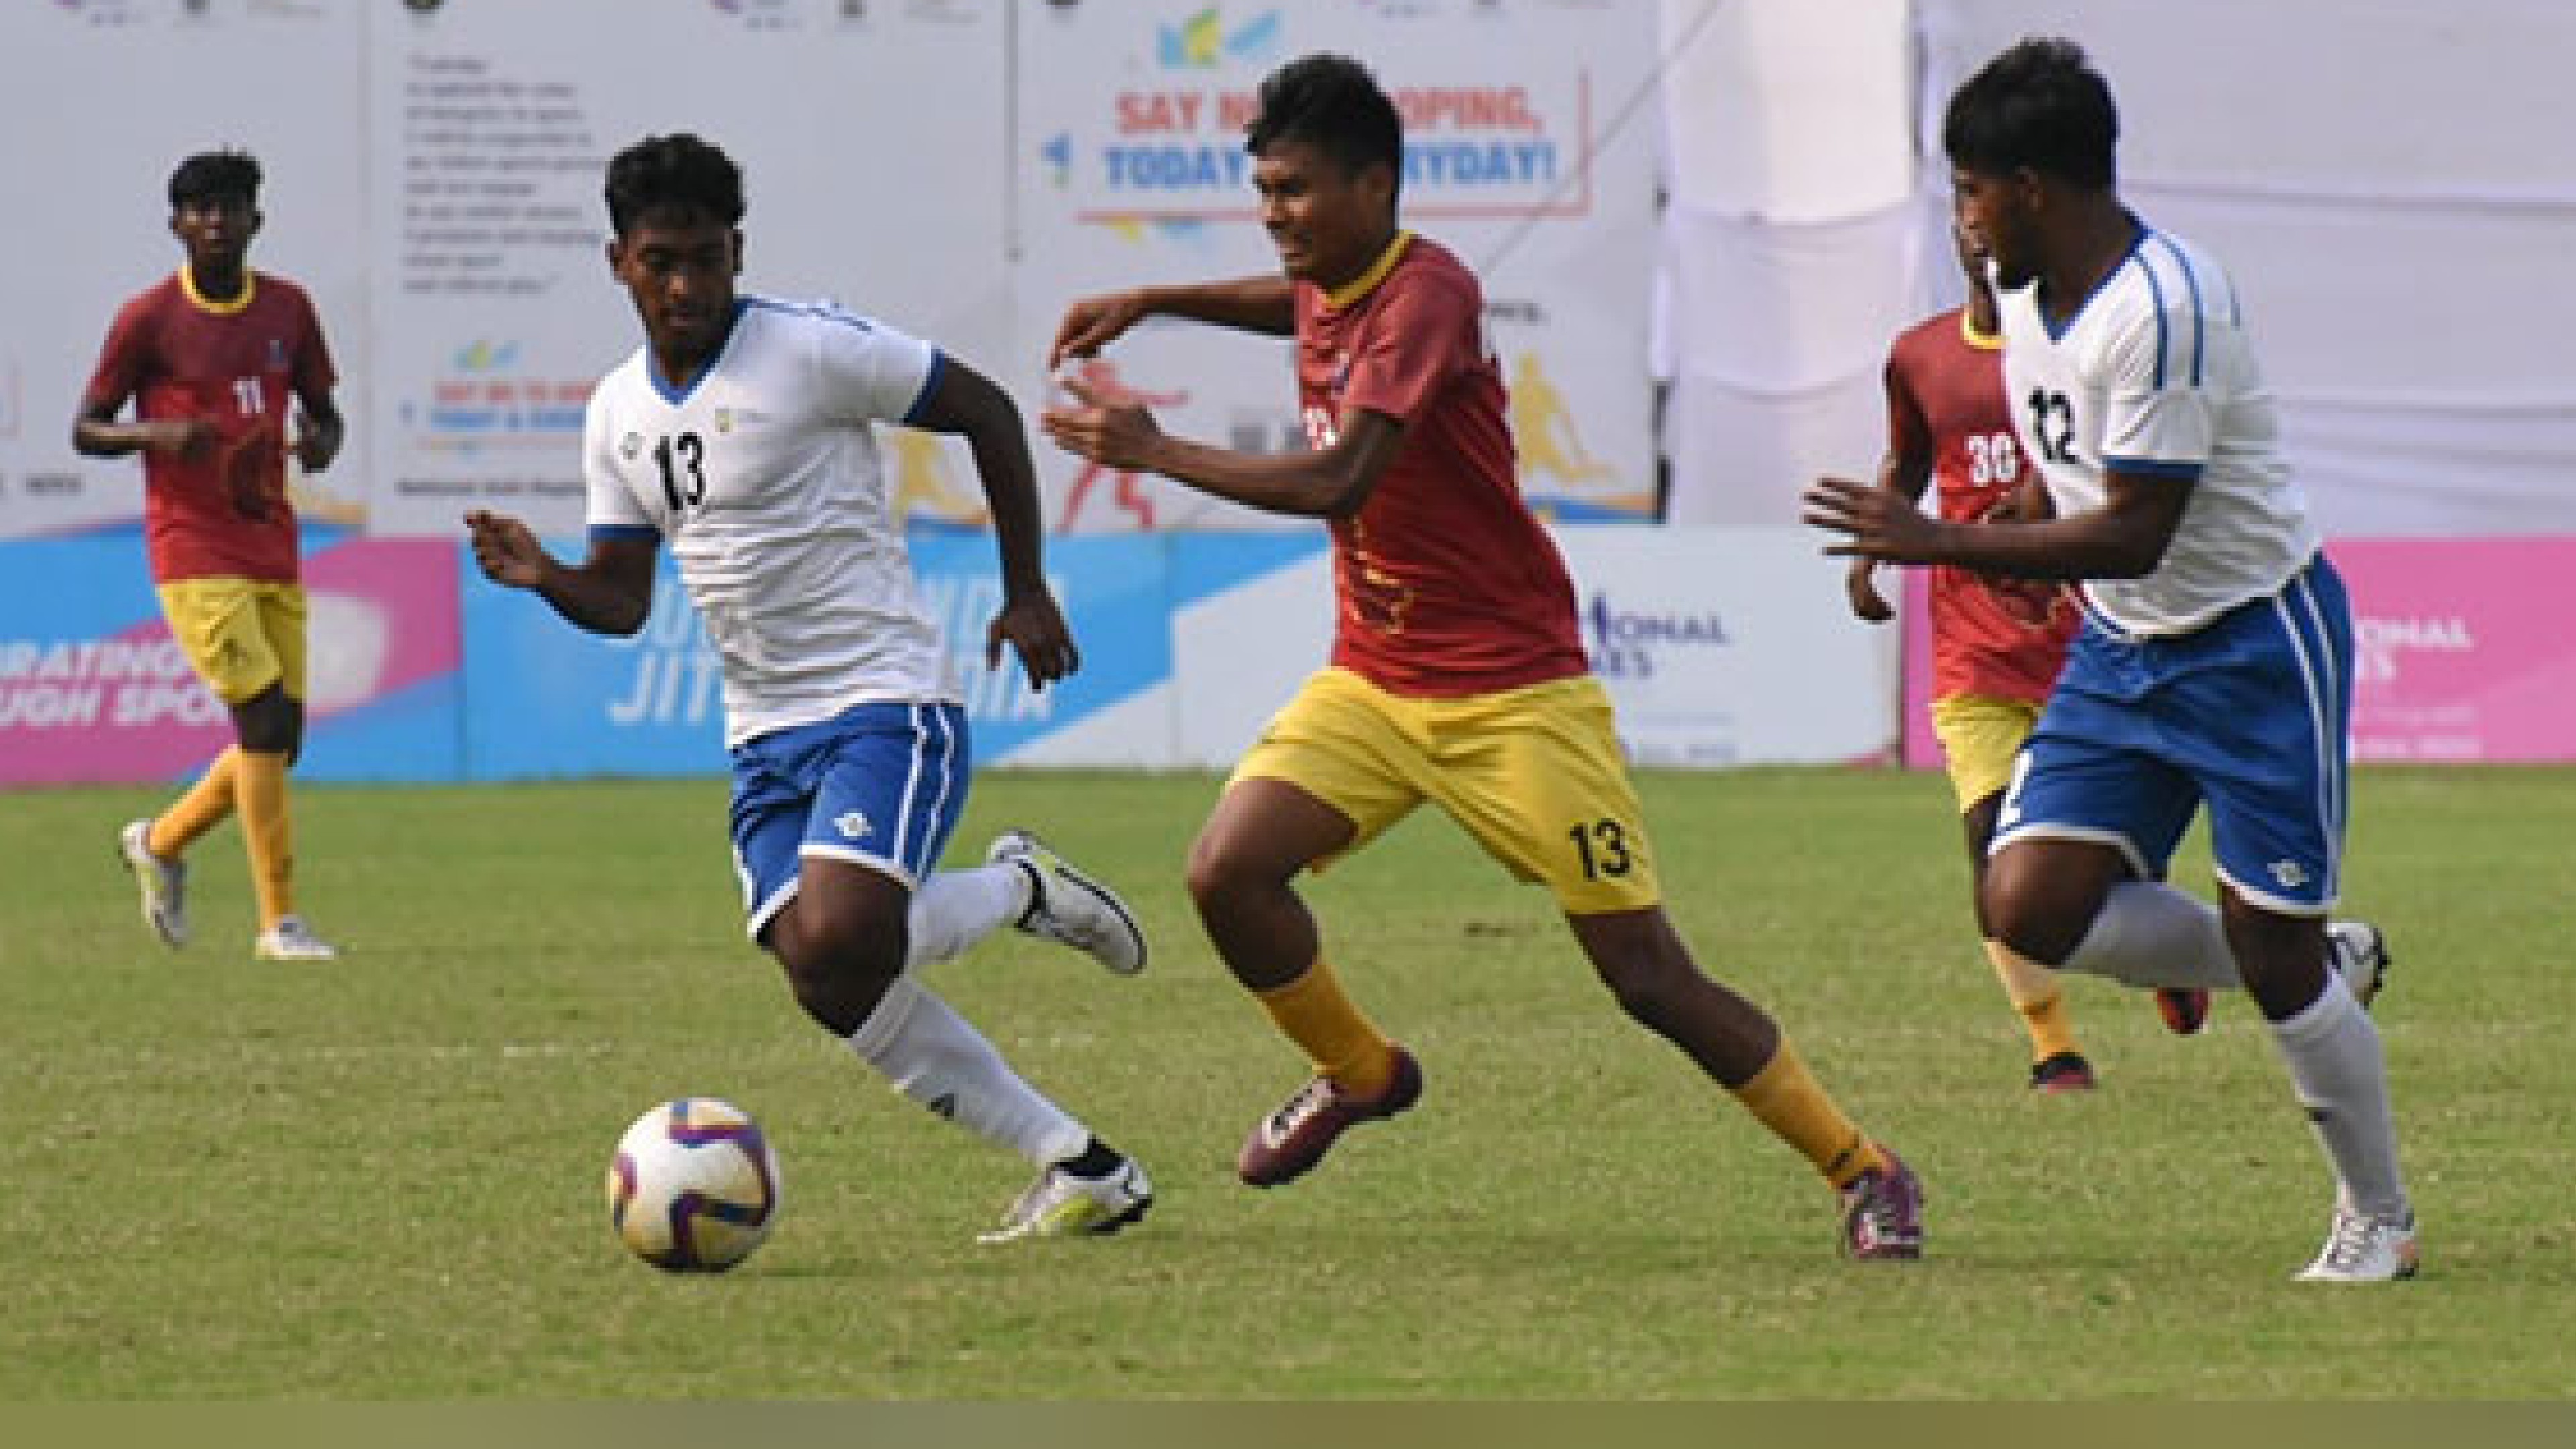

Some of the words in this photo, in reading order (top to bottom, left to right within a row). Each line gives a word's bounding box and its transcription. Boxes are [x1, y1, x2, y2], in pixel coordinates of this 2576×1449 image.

[1116, 91, 1203, 134] SAY
[1218, 91, 1263, 133] N
[1397, 87, 1544, 136] OPING,
[1104, 144, 1248, 189] TODAY
[1404, 141, 1555, 185] RYDAY!
[233, 377, 265, 415] 11
[2029, 388, 2078, 464] 12
[653, 431, 706, 511] 13
[0, 639, 185, 679] RATING
[0, 684, 102, 726] UGH
[1568, 818, 1632, 883] 13
